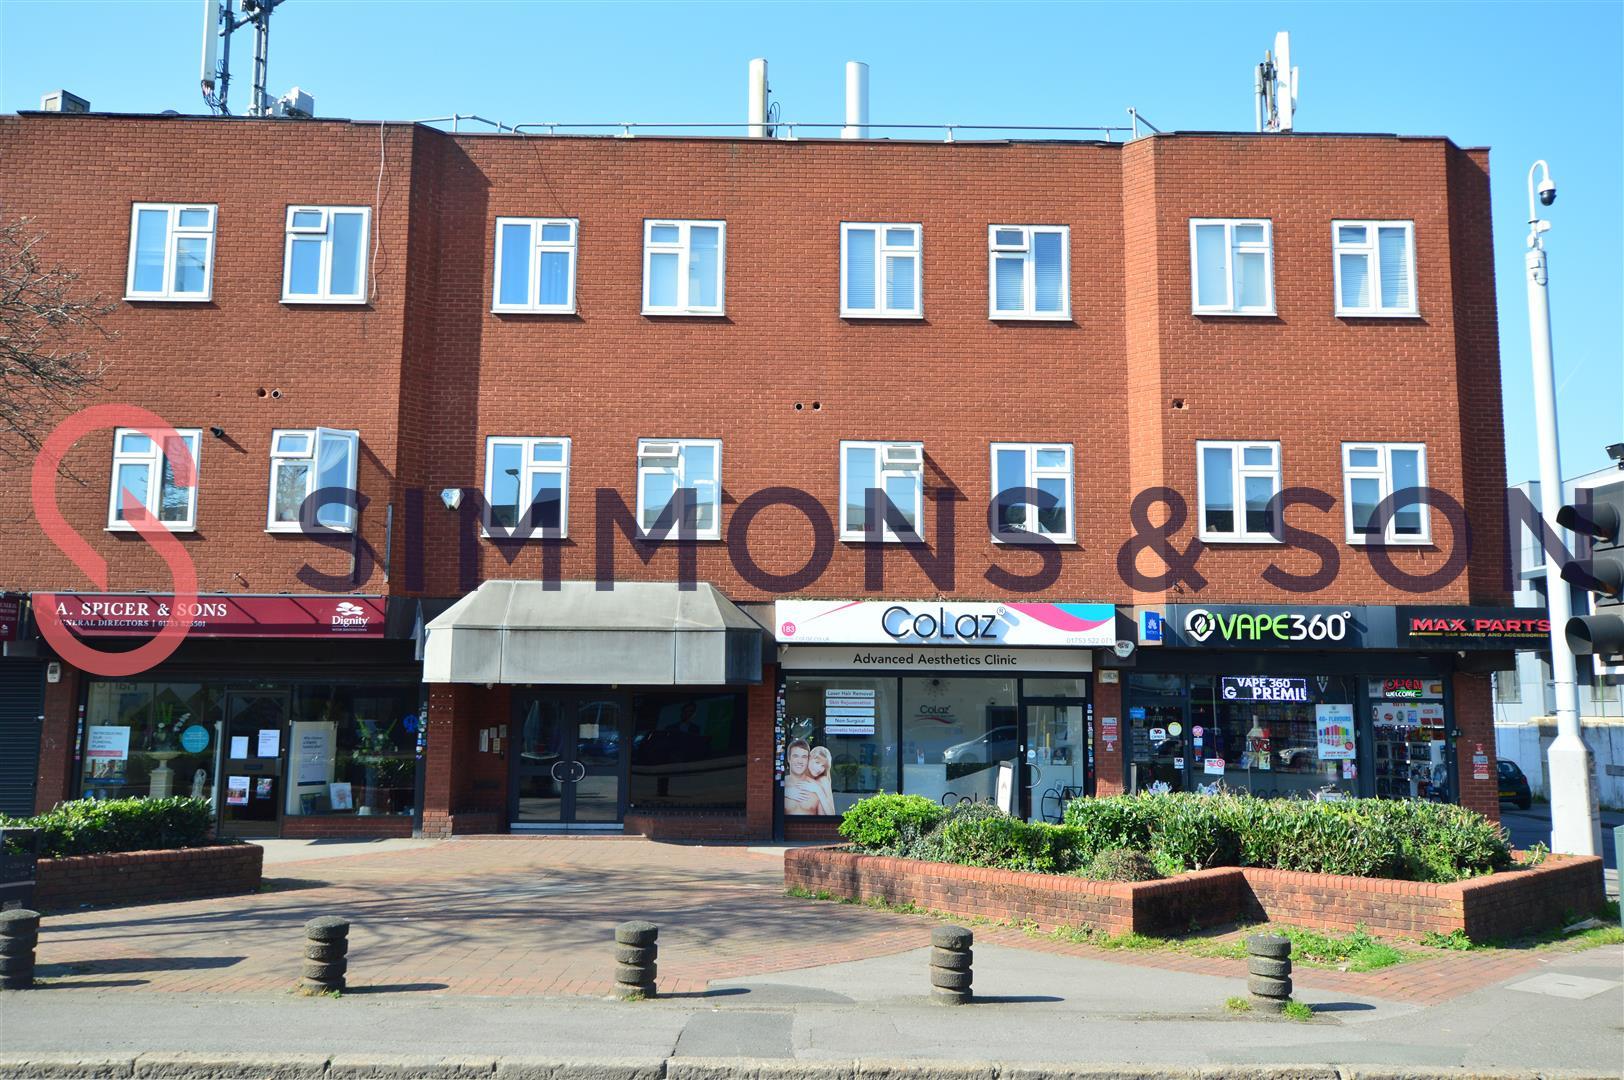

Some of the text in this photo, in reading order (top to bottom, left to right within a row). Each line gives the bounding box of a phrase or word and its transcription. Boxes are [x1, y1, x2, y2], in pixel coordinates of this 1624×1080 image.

[56, 602, 227, 617] A. SPICER & SONS
[98, 619, 149, 628] DIRECTORS
[332, 615, 369, 628] Dignity
[1412, 618, 1551, 632] MAX PARTS
[782, 625, 795, 633] 183
[853, 653, 1017, 665] Advanced Aesthetics Clinic
[1237, 678, 1291, 688] VAPE 360
[1384, 678, 1423, 690] OPEN
